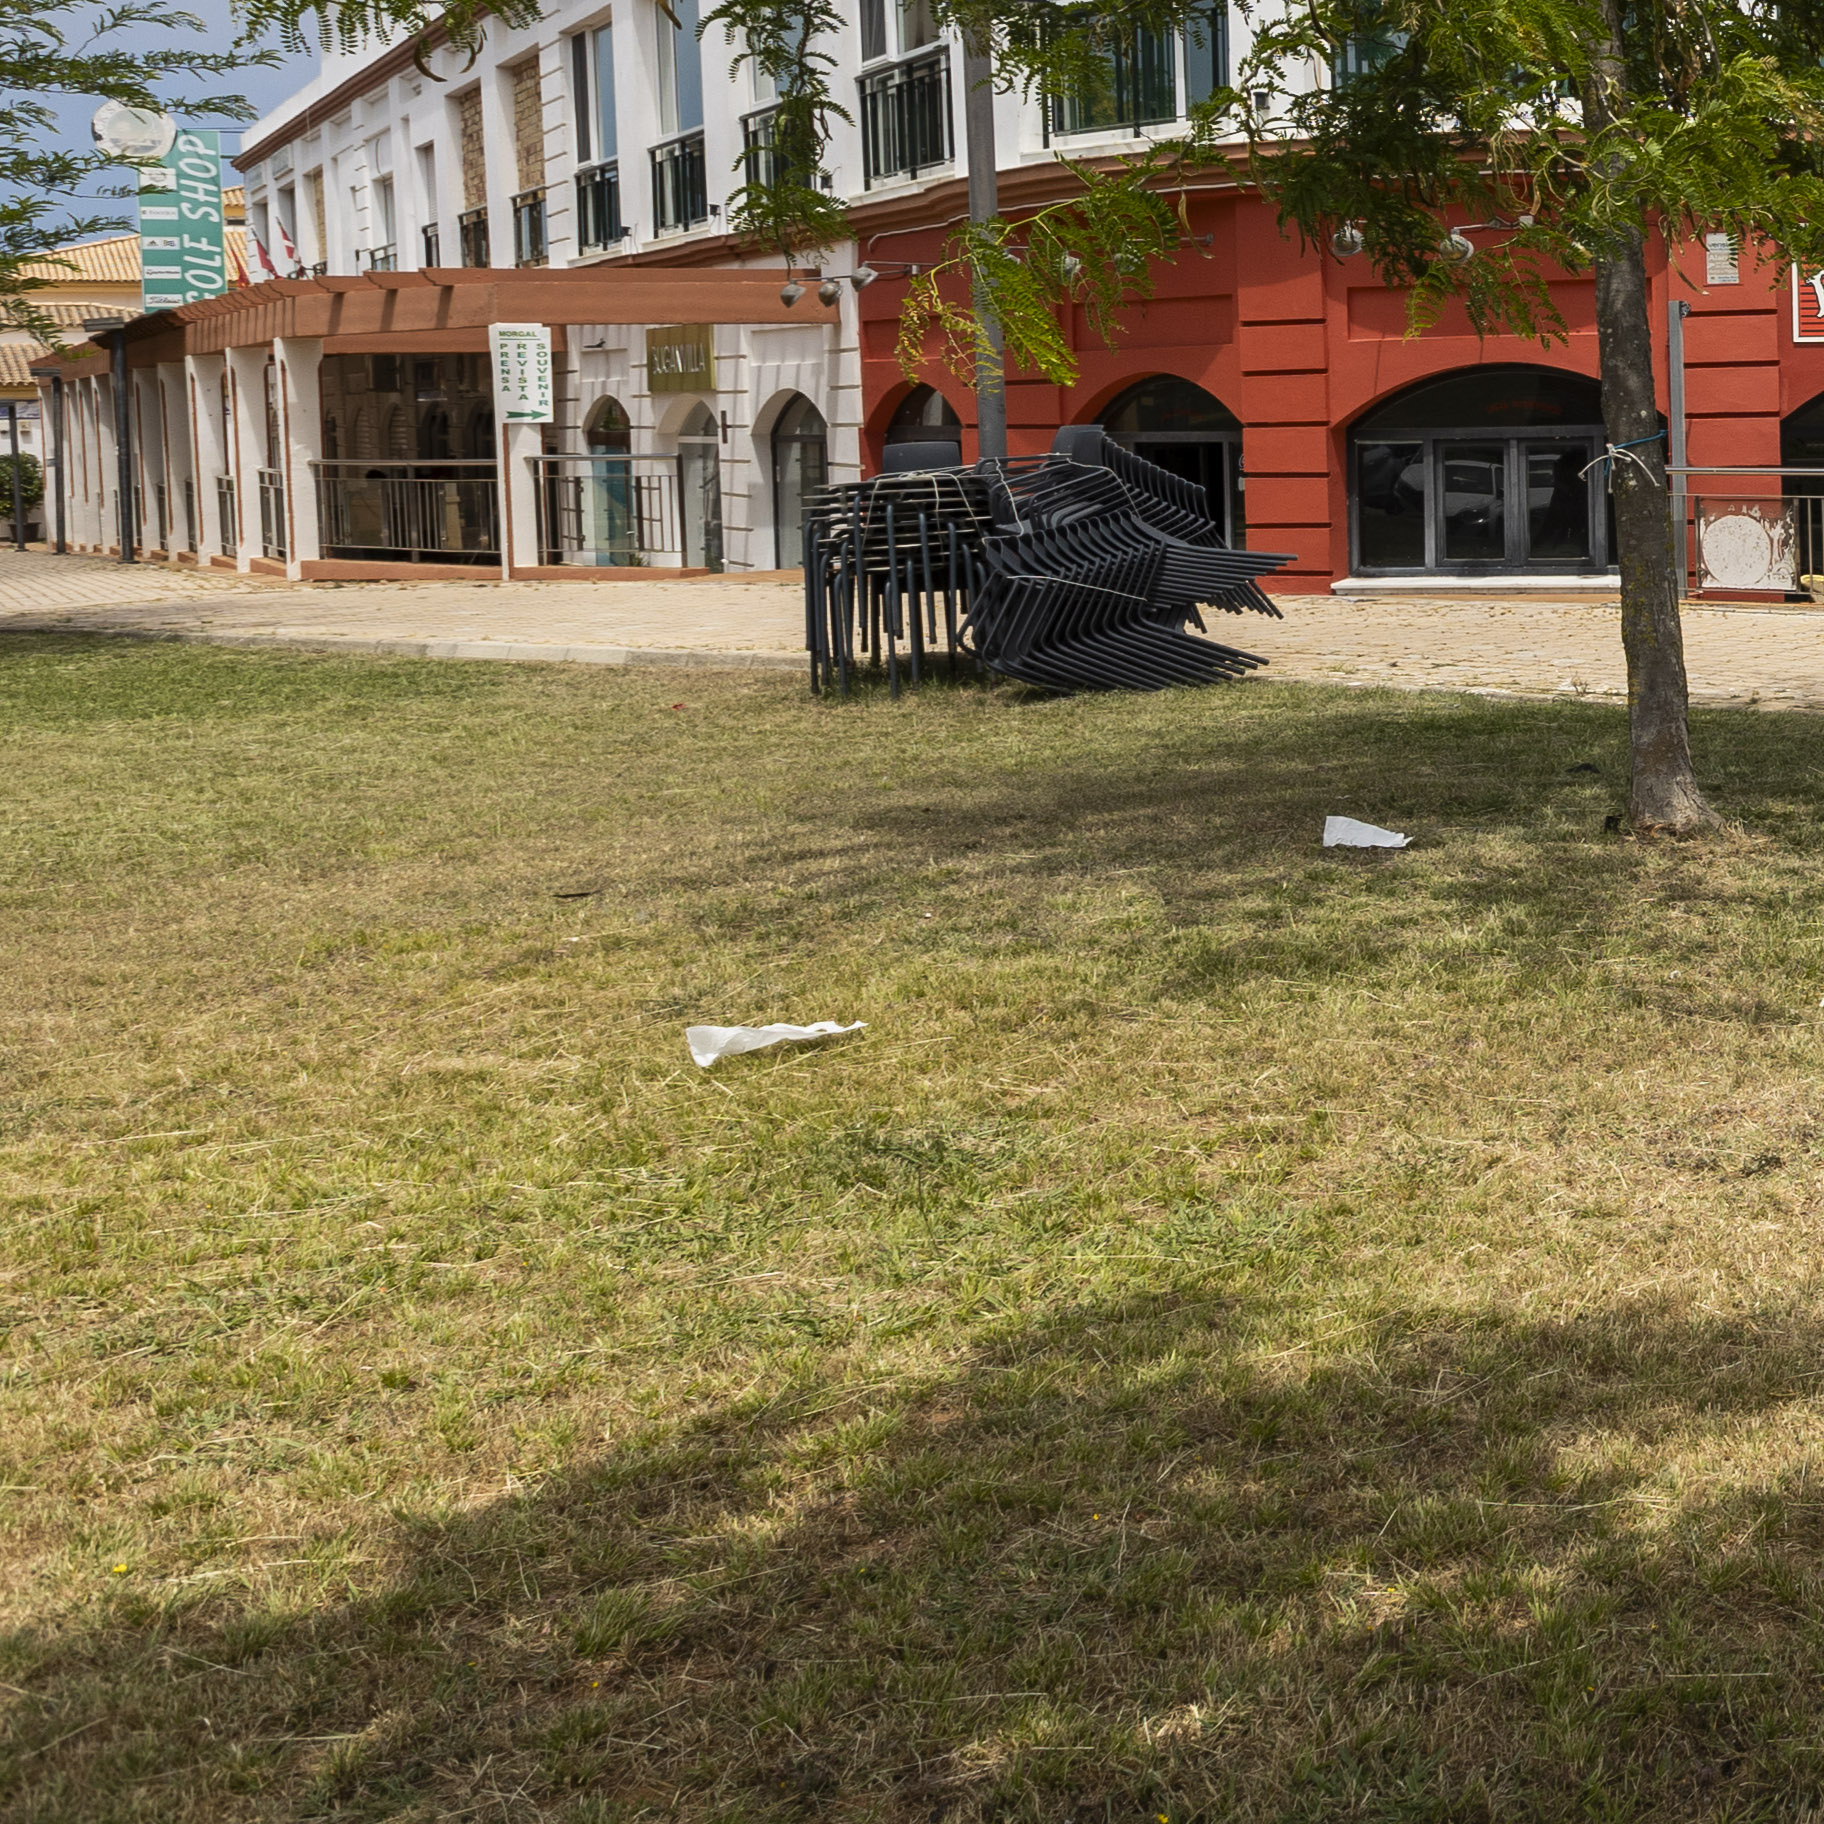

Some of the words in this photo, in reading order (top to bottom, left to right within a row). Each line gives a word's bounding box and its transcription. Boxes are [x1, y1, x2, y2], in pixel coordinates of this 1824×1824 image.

[178, 135, 220, 222] SHOP
[500, 343, 511, 392] PRENSA
[517, 343, 528, 401] REVISTA
[536, 342, 549, 407] SOUVENIR
